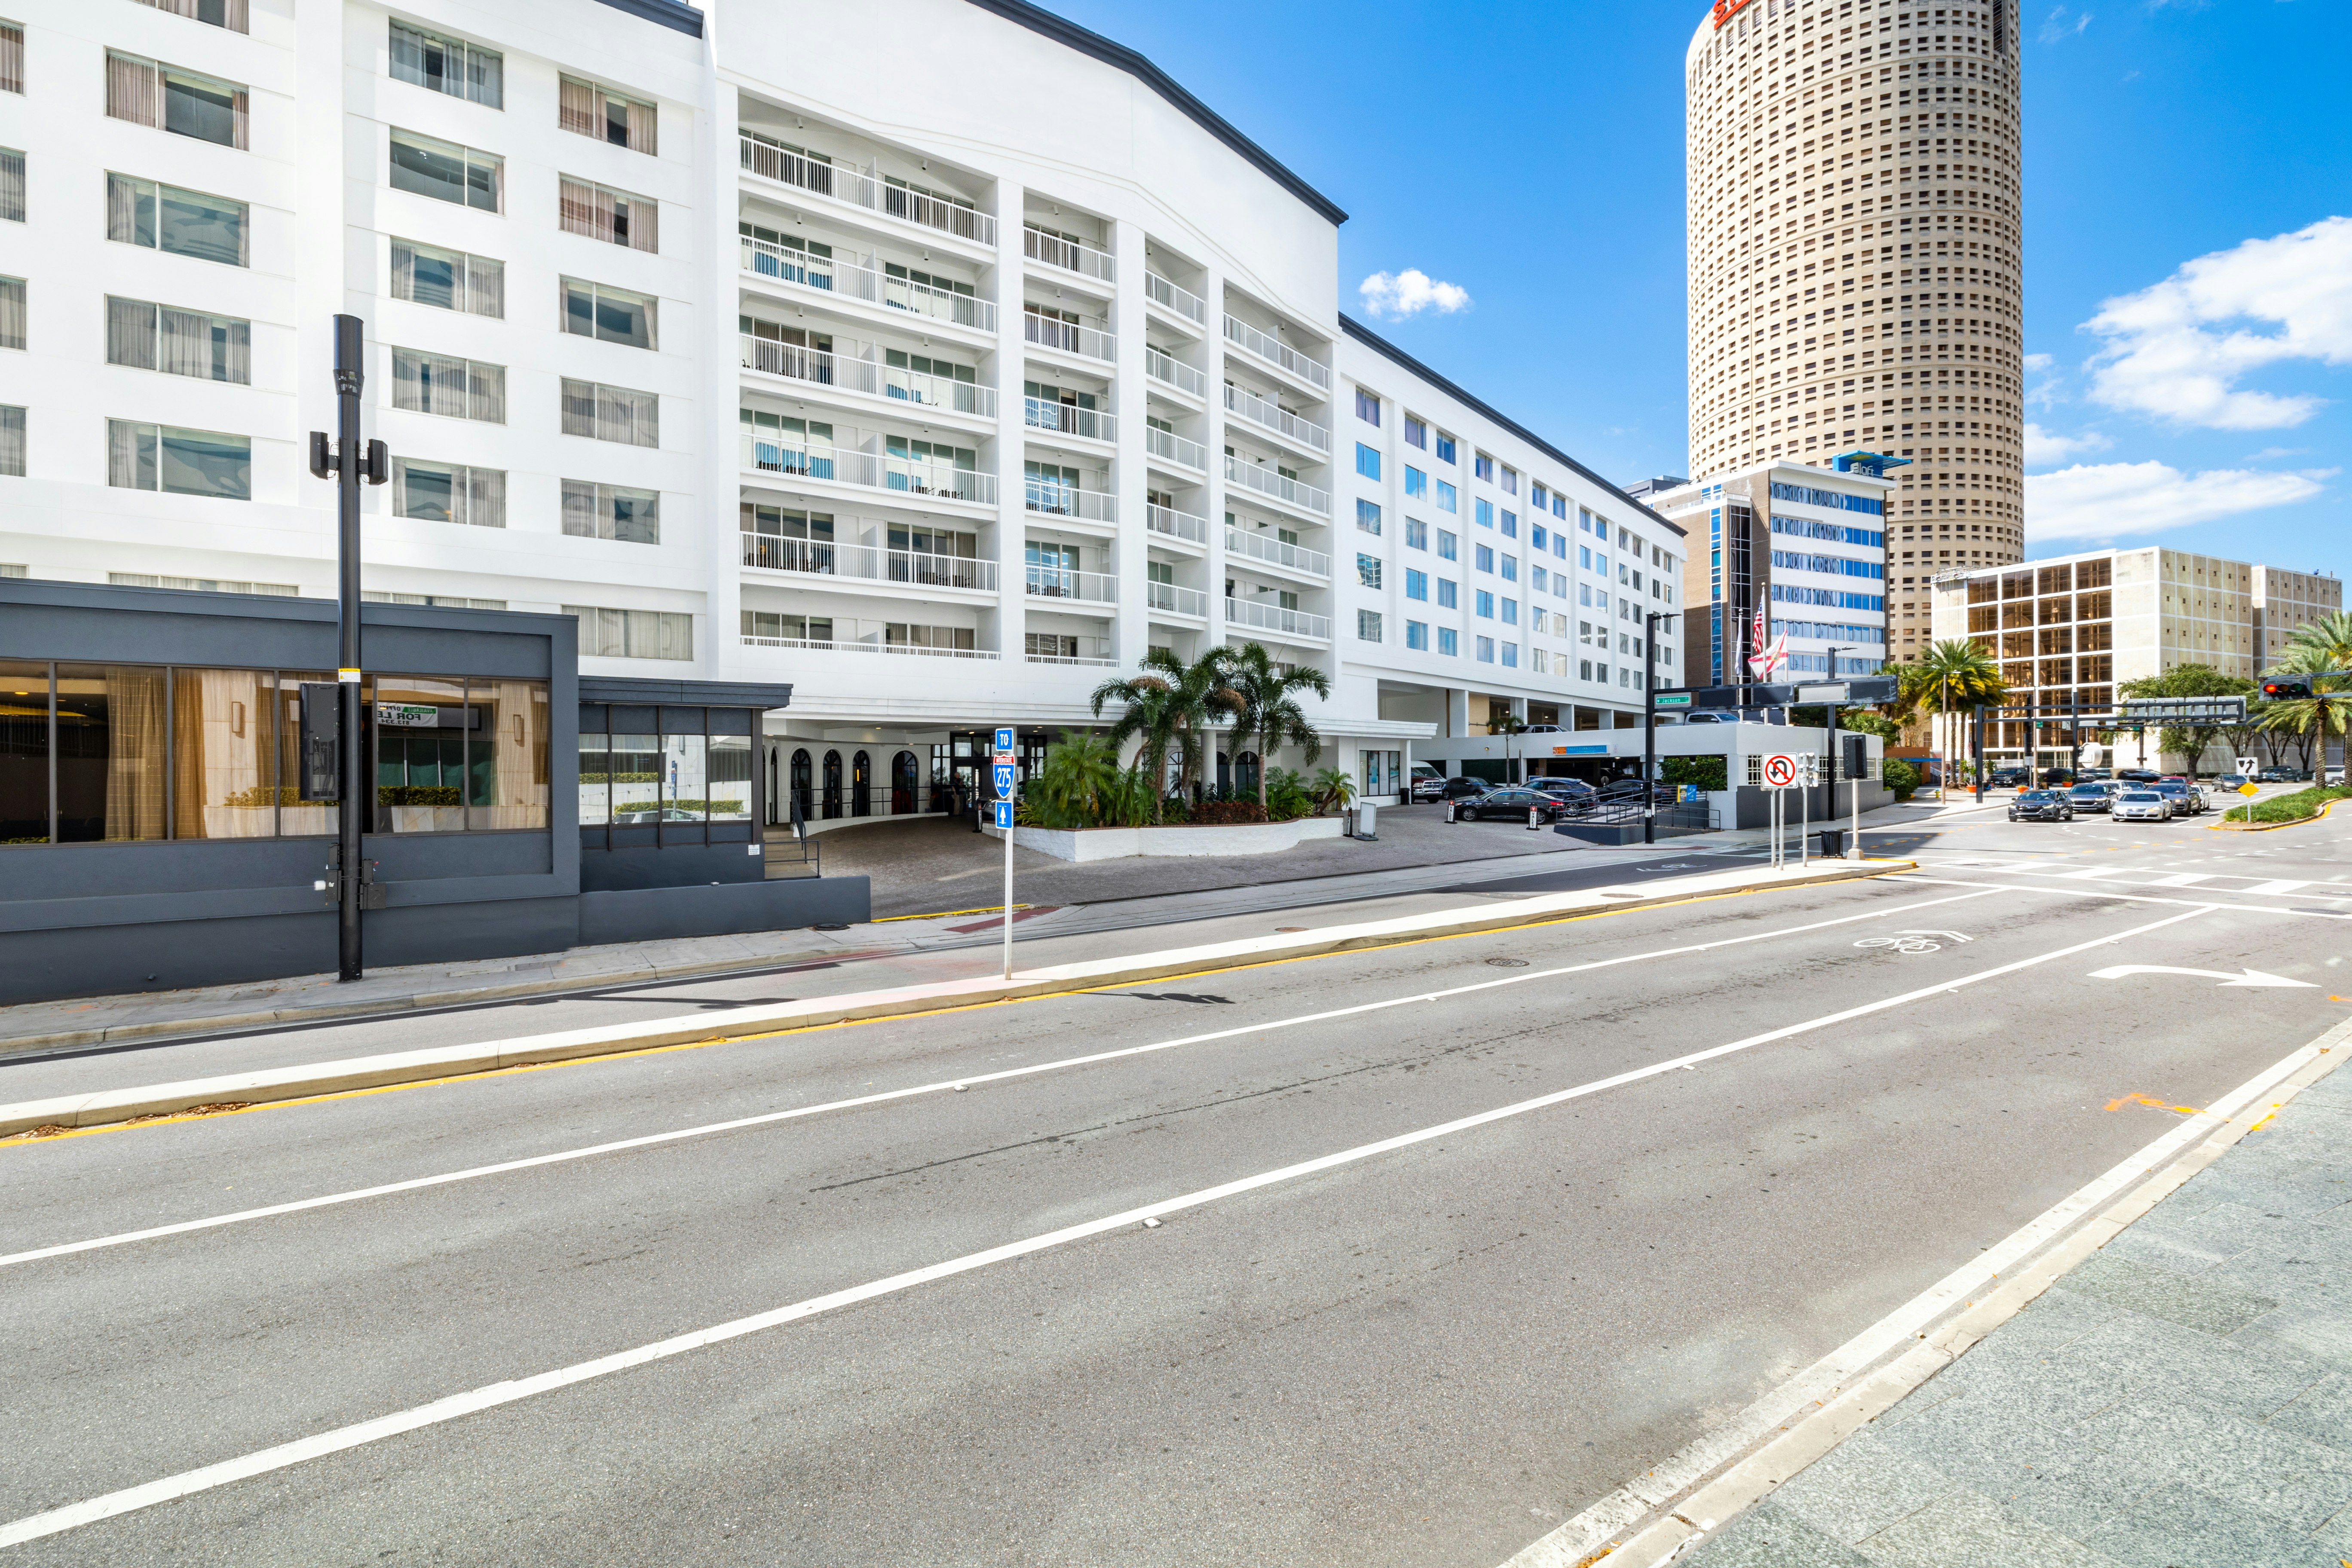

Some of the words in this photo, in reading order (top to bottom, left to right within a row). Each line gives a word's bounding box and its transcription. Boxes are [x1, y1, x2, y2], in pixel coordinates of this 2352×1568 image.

[1851, 462, 1874, 477] aloft
[999, 733, 1009, 746] TO
[997, 767, 1011, 788] 275
